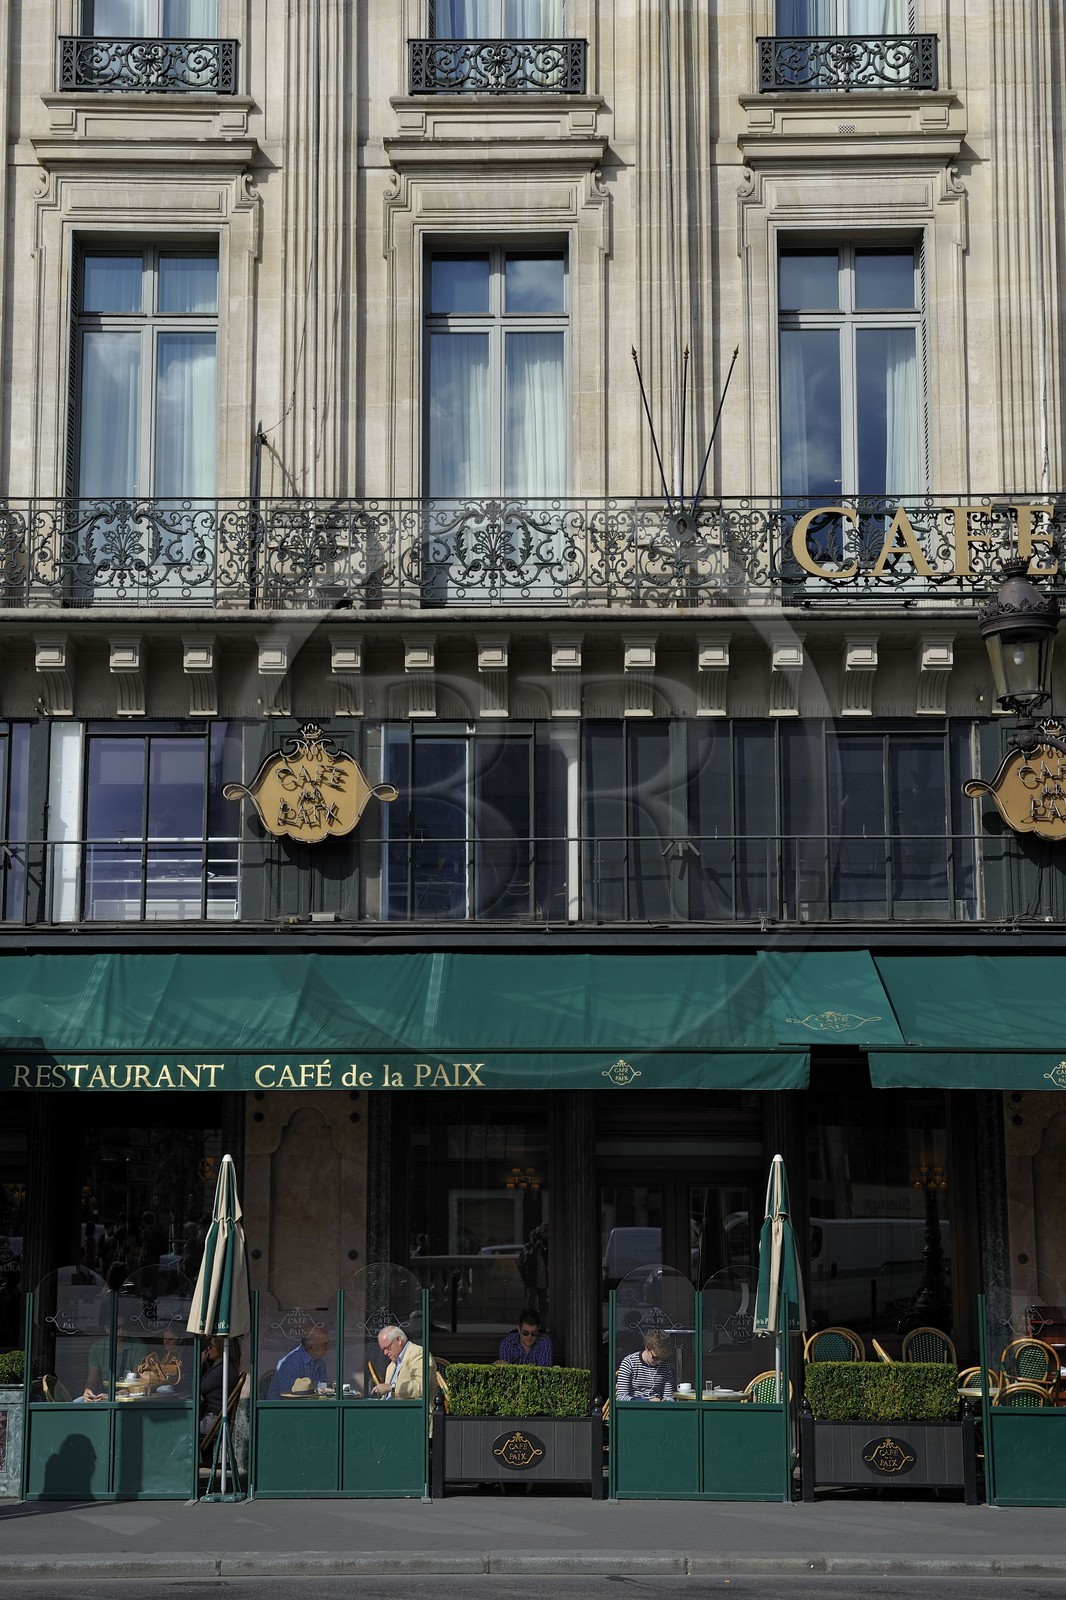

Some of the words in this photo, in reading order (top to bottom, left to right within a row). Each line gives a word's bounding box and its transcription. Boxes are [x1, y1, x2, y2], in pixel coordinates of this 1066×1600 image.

[12, 1063, 225, 1088] RESTAURANT
[254, 1058, 333, 1088] CAFÉ
[341, 1064, 373, 1087] de
[382, 1064, 404, 1087] la
[413, 1063, 487, 1087] PAIX
